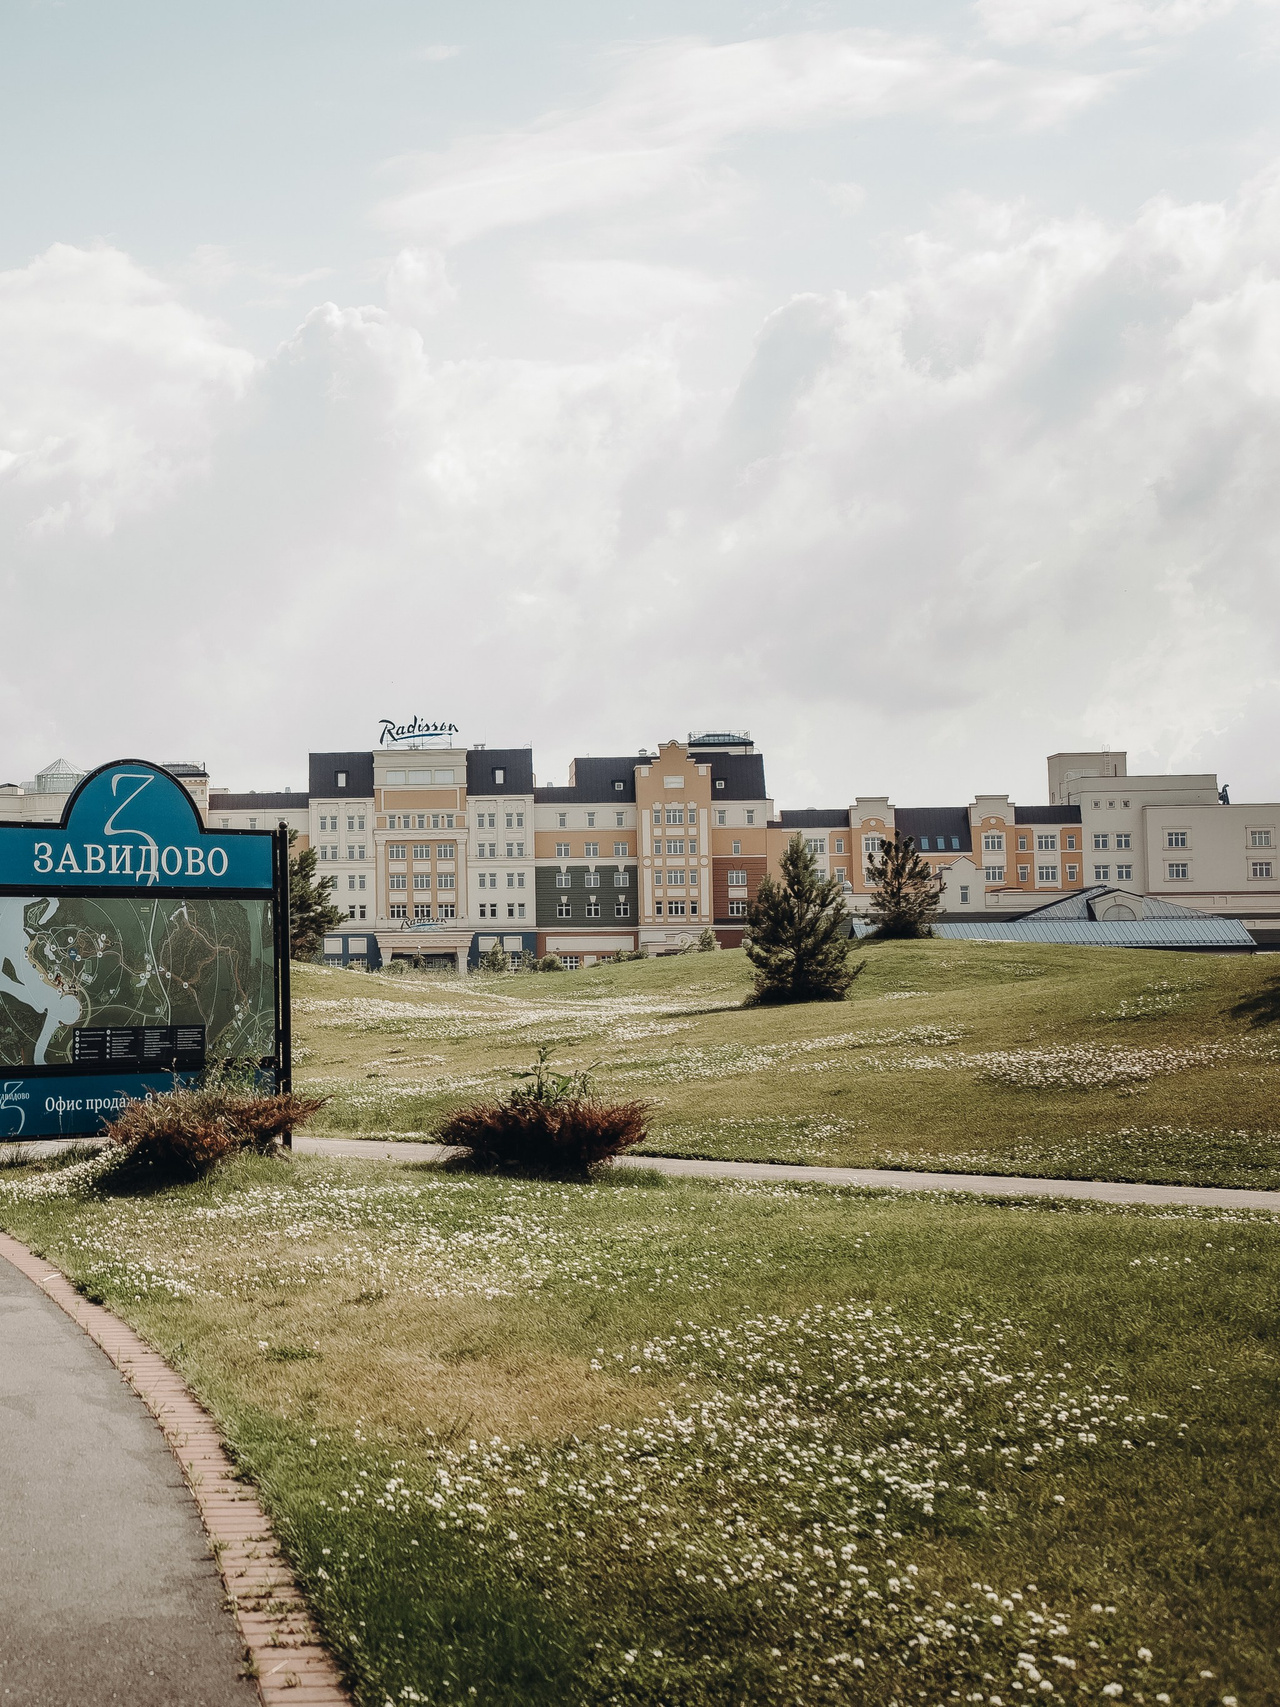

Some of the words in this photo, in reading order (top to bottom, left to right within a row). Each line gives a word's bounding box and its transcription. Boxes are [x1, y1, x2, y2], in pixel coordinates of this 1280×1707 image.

[378, 715, 459, 745] Radisson
[33, 842, 229, 882] ЗАВИДОВО
[400, 912, 448, 930] Radisson
[45, 1096, 83, 1115] Офис
